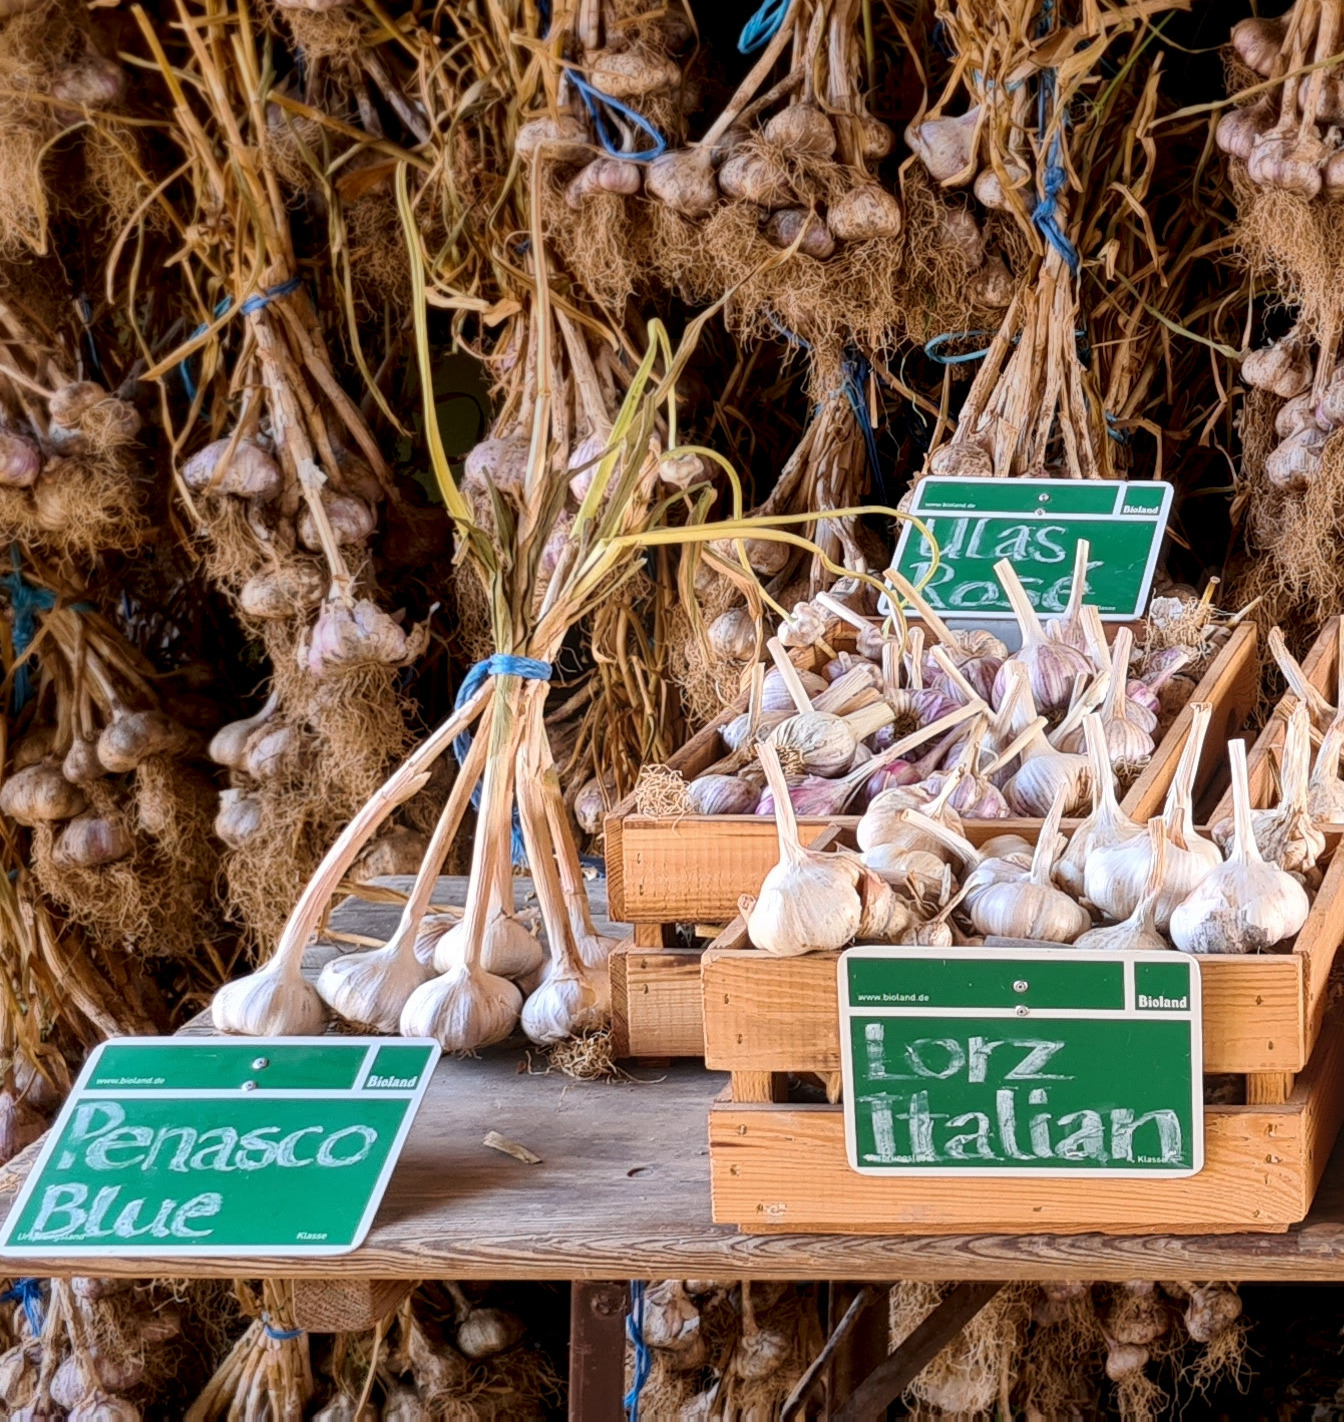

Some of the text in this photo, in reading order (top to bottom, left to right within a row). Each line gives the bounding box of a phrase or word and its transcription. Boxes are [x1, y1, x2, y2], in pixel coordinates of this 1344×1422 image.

[1123, 505, 1158, 514] Bioland
[858, 993, 930, 1002] www.bioland.de
[1138, 995, 1187, 1009] Bioland
[862, 1023, 1075, 1082] Lorz
[97, 1076, 165, 1086] www.bioland.de
[367, 1075, 418, 1089] Bioland
[856, 1087, 1184, 1164] Italian
[57, 1101, 378, 1172] Penasco
[32, 1182, 223, 1239] Blue
[297, 1231, 327, 1240] Klasse
